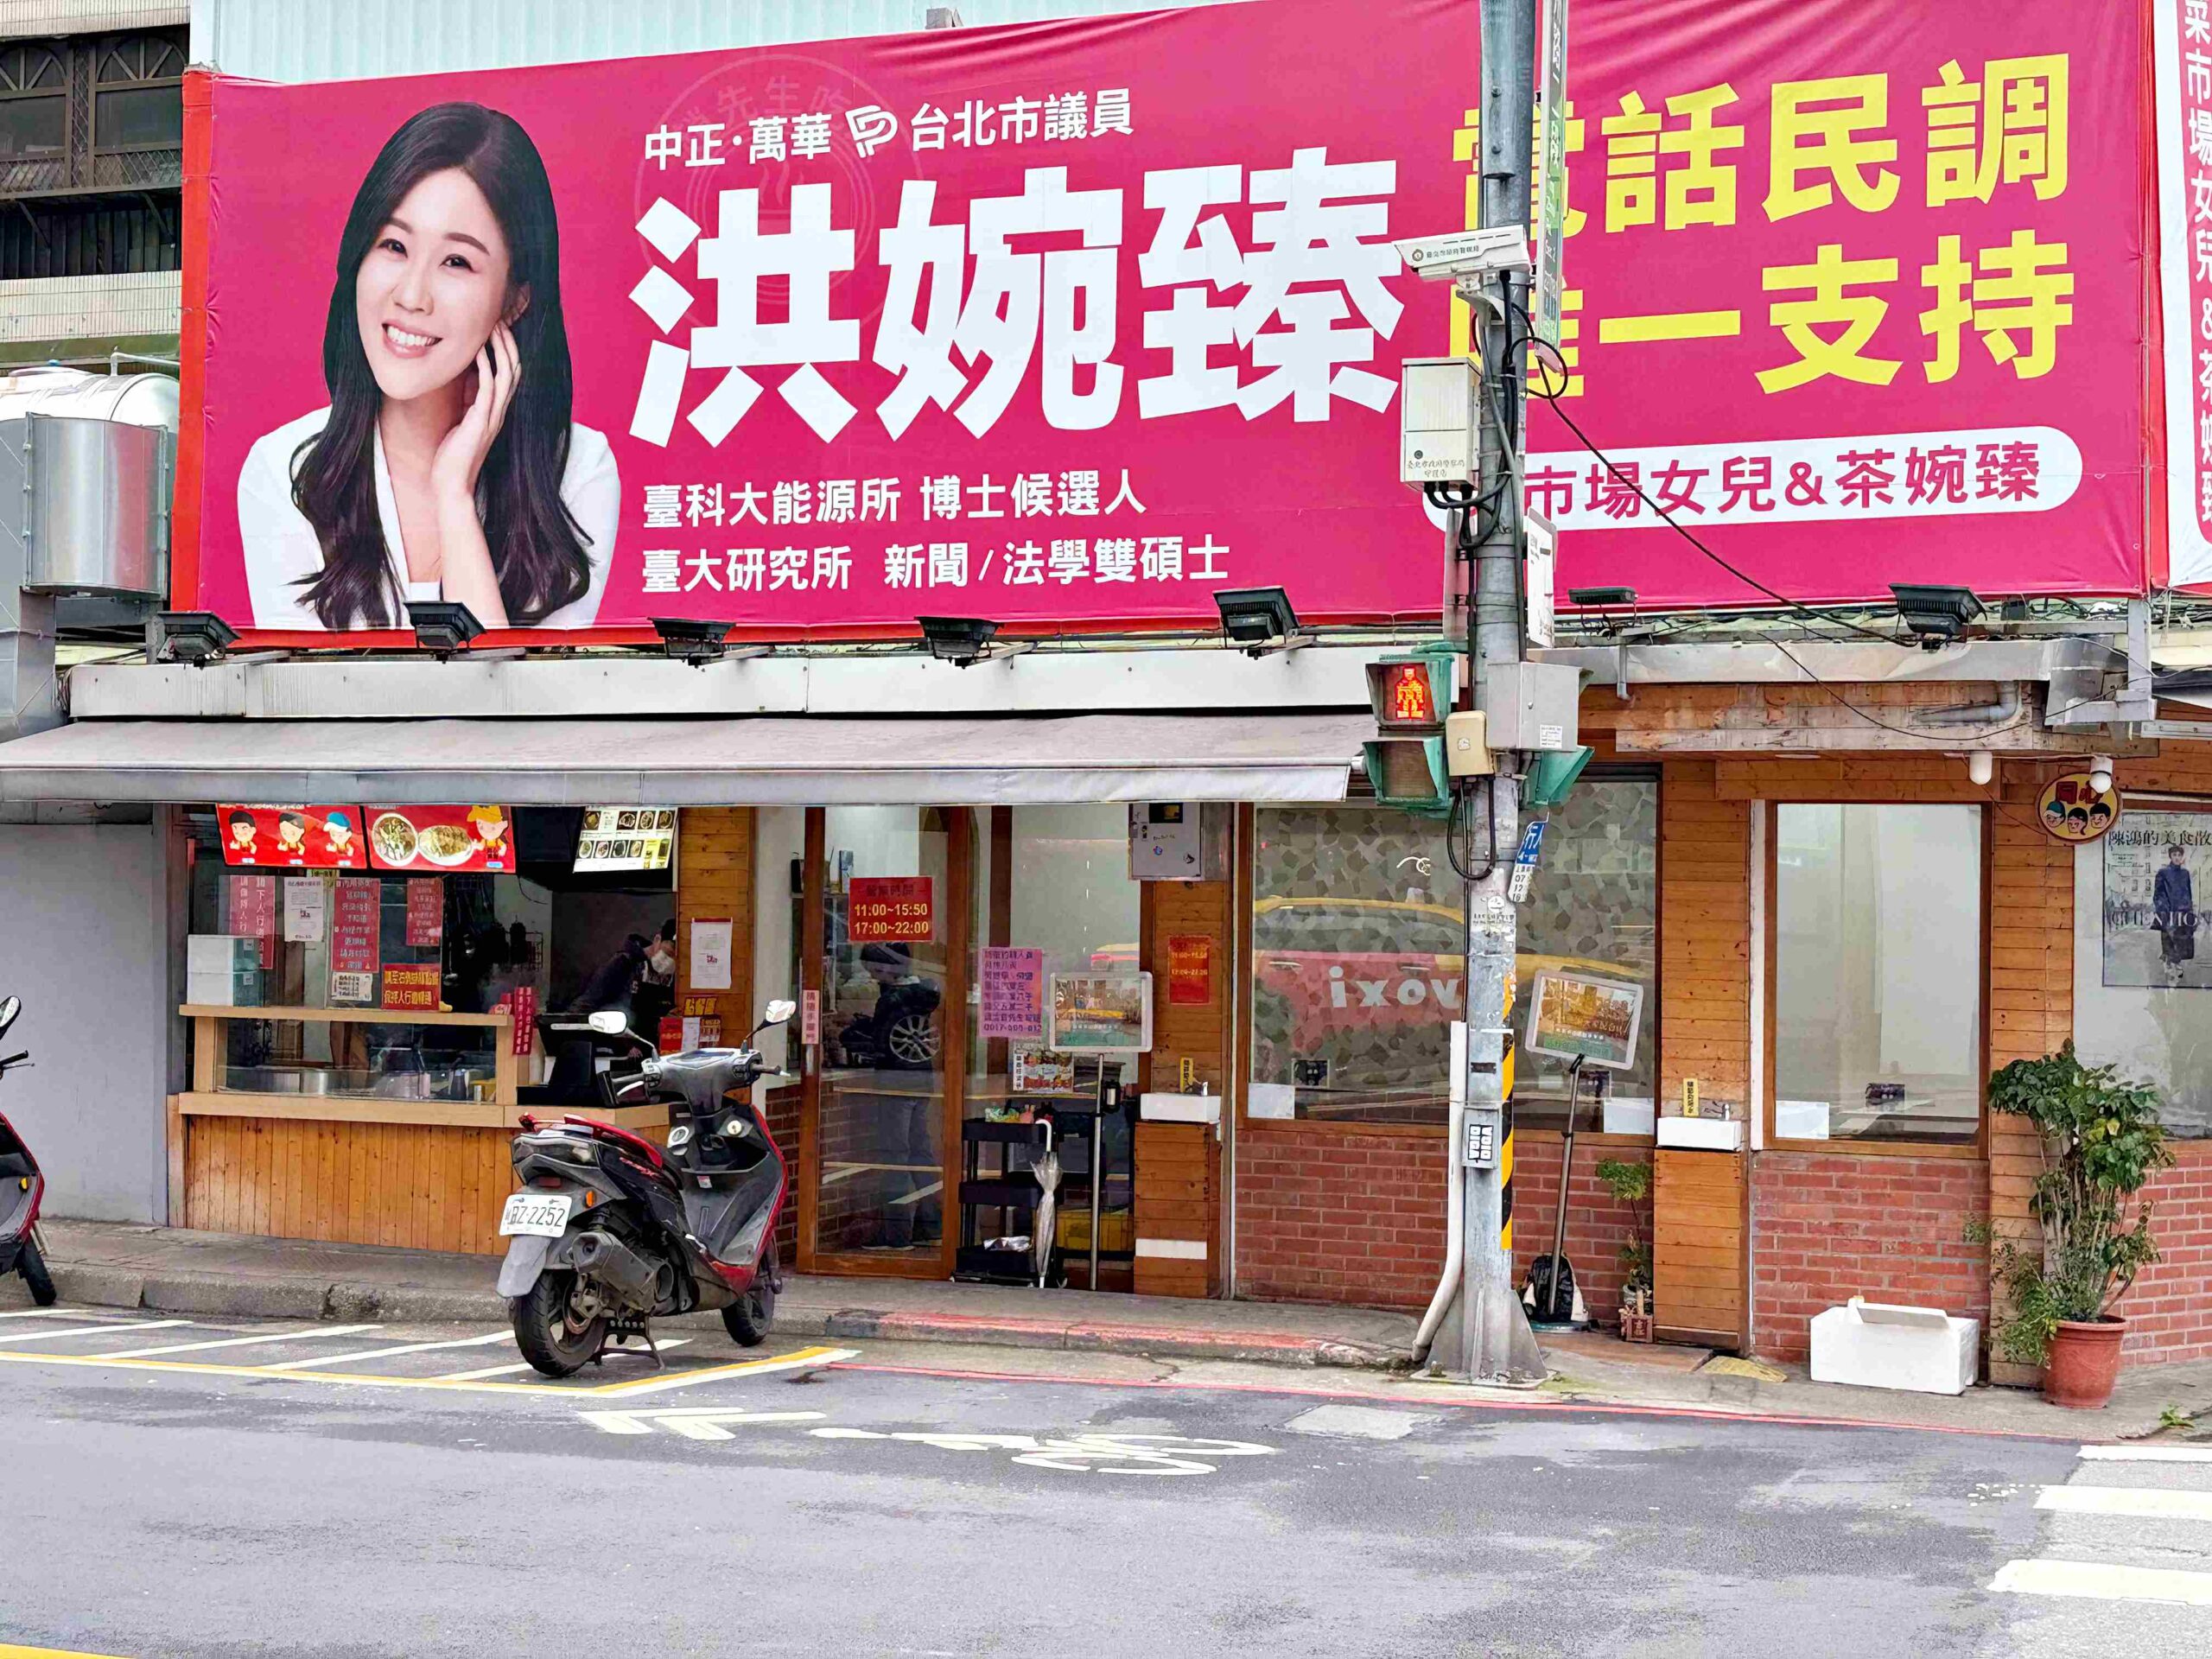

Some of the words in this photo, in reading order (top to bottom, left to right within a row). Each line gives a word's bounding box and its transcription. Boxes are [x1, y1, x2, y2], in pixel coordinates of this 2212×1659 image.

[911, 88, 1133, 152] 台北市議員
[629, 145, 1406, 448] 洪婉臻
[643, 478, 901, 528] 臺科大能源所
[919, 468, 1147, 519] 博士候選人
[1523, 441, 2040, 520] 市場女兒&茶婉臻
[642, 545, 852, 593] 臺大研究所
[854, 903, 928, 917] 11:00~15:50
[855, 921, 929, 935] 17:00~22:00
